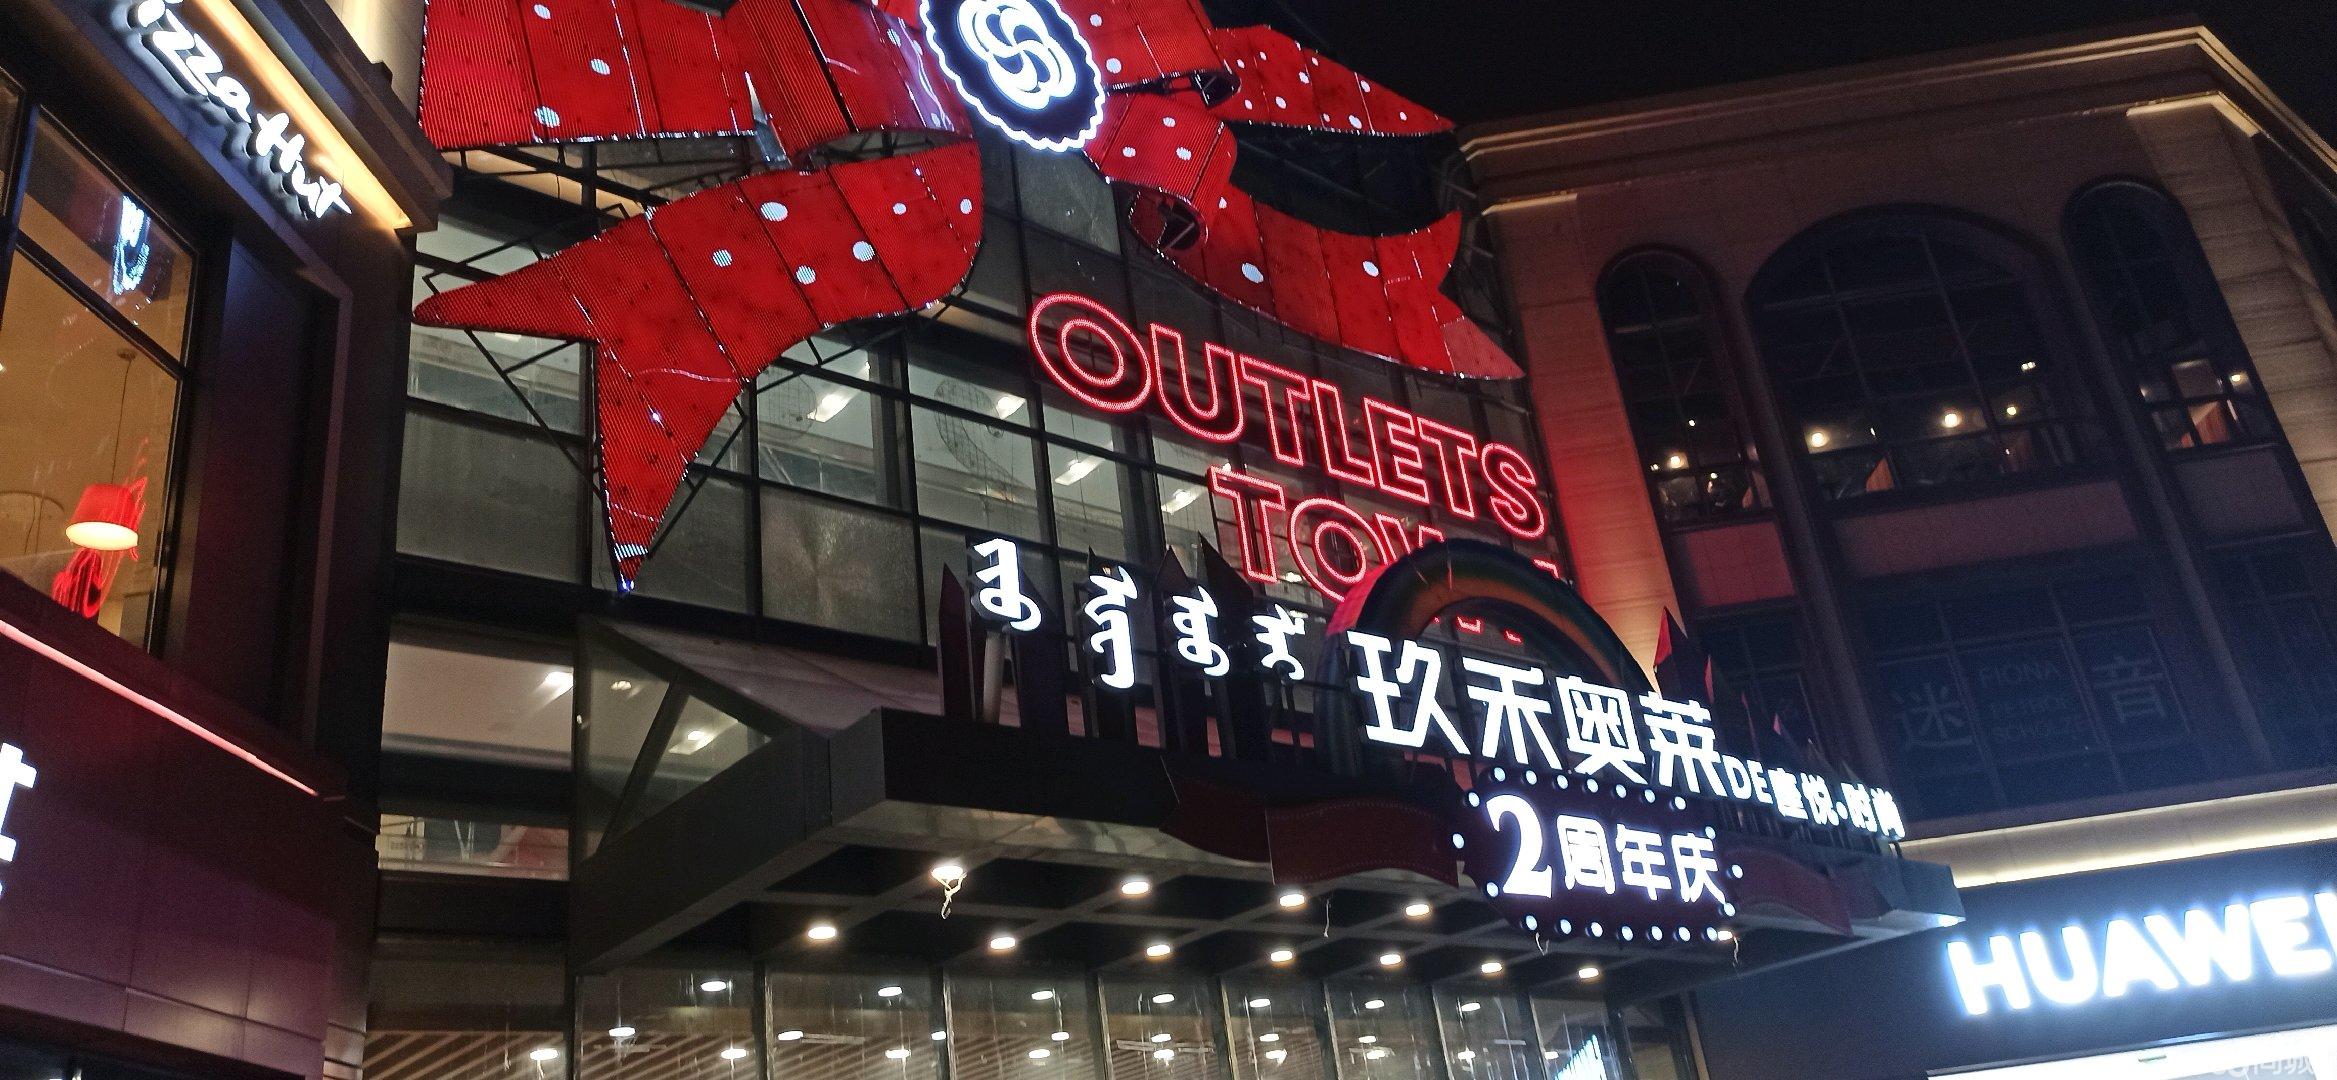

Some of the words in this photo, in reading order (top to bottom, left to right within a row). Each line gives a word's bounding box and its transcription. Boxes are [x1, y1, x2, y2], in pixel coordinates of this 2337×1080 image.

[256, 112, 352, 218] Hut
[1030, 291, 1547, 540] OUTLETS
[1346, 630, 1728, 798] 玖禾奥莱
[1978, 660, 2061, 689] FIONA
[2090, 654, 2167, 725] 音
[1486, 794, 1727, 904] 2周年庆
